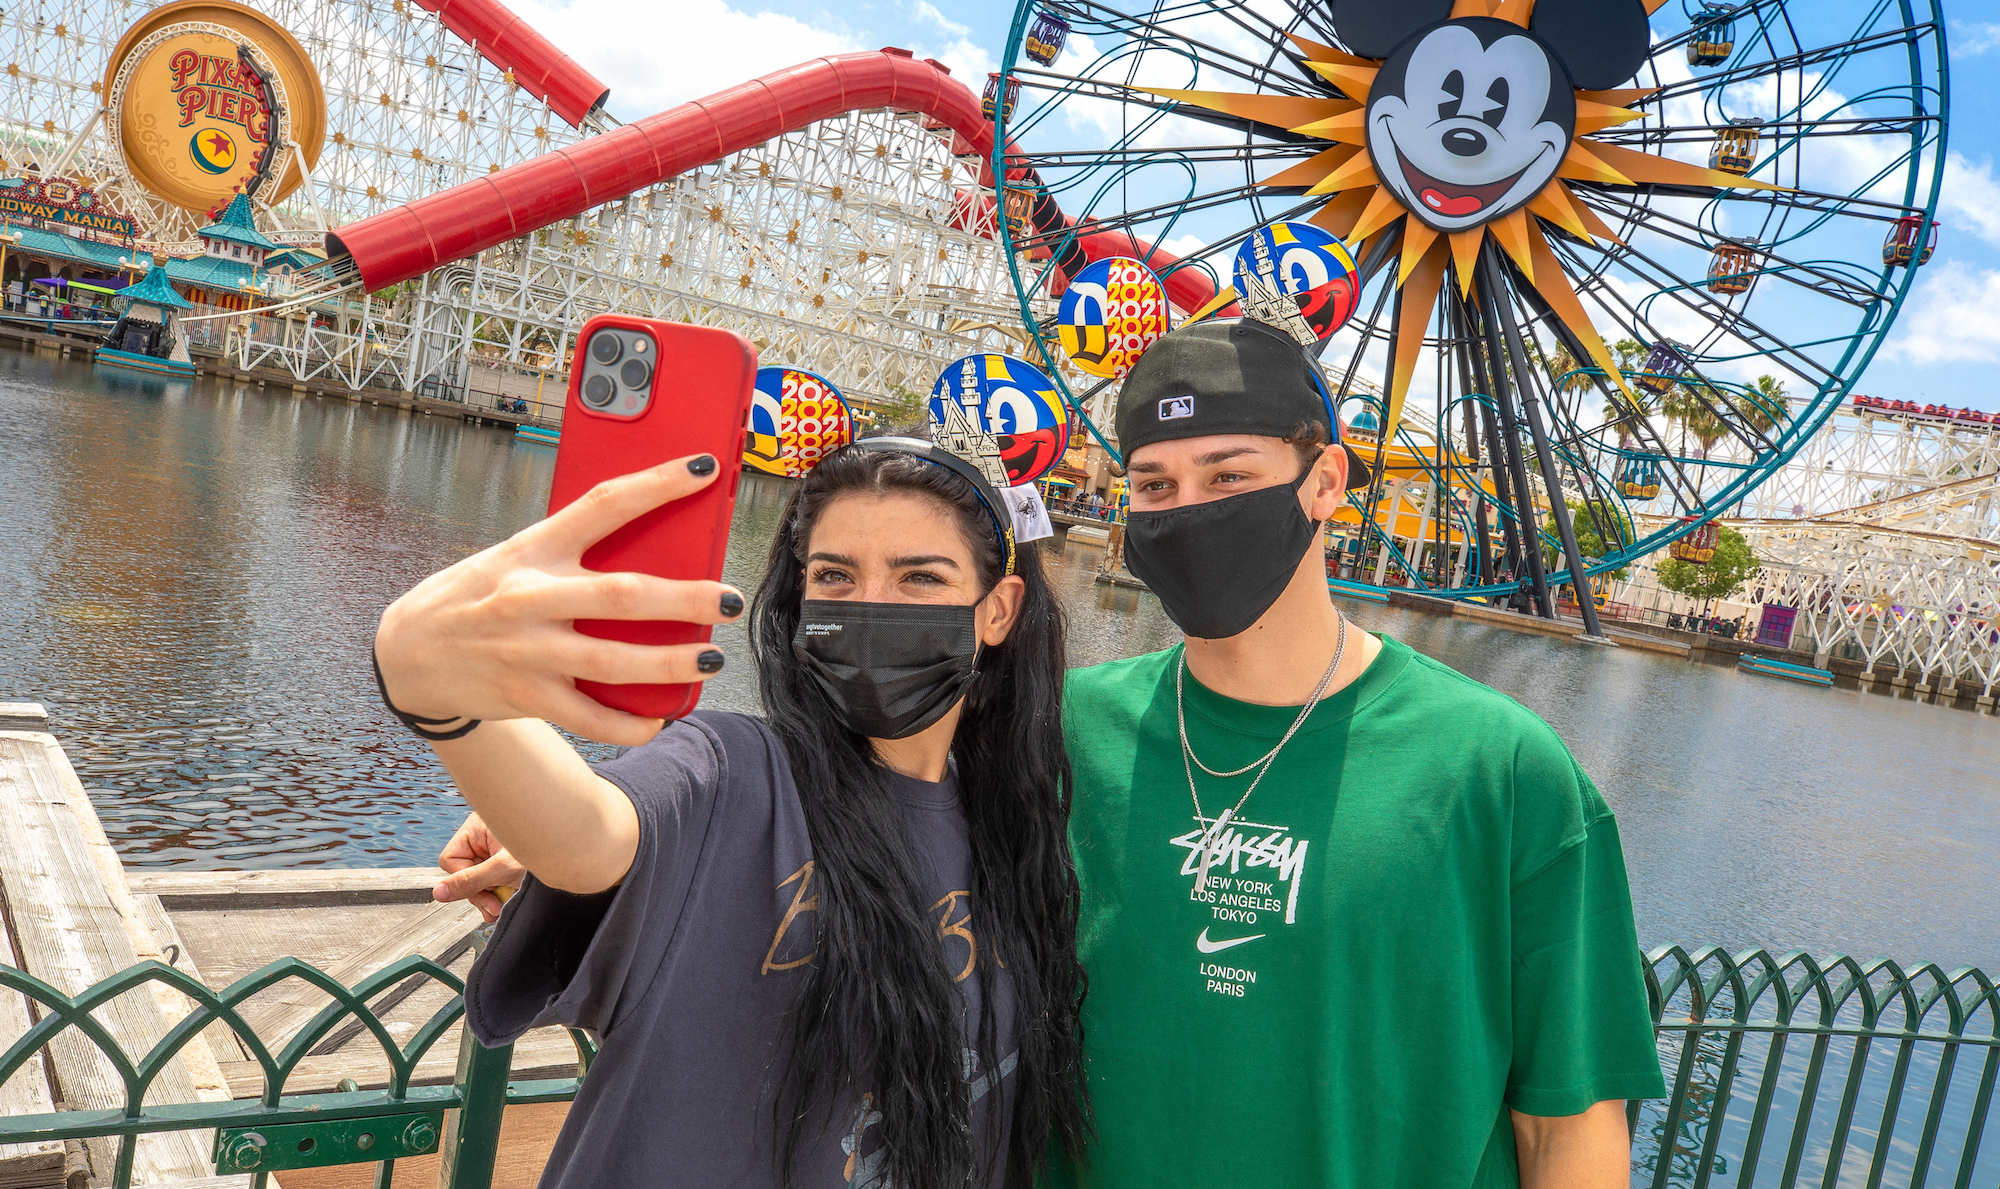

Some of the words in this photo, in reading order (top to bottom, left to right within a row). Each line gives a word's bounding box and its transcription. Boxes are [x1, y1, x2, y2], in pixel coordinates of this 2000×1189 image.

[169, 48, 259, 97] PIXA
[177, 86, 263, 143] PIER
[0, 199, 58, 219] IDWAY
[63, 210, 130, 233] MANIA!
[1107, 299, 1166, 320] 2021
[1108, 315, 1167, 337] 2021
[1109, 331, 1167, 351] 202
[781, 415, 850, 436] 2021
[781, 430, 850, 448] 2021
[782, 443, 850, 459] 202
[1203, 876, 1232, 890] NEW
[1235, 879, 1273, 895] YORK
[1190, 888, 1216, 903] LOS
[1219, 893, 1281, 912] ANGELES
[1211, 906, 1257, 925] TOKYO
[1199, 962, 1257, 983] LONDON
[1206, 979, 1245, 997] PARIS
